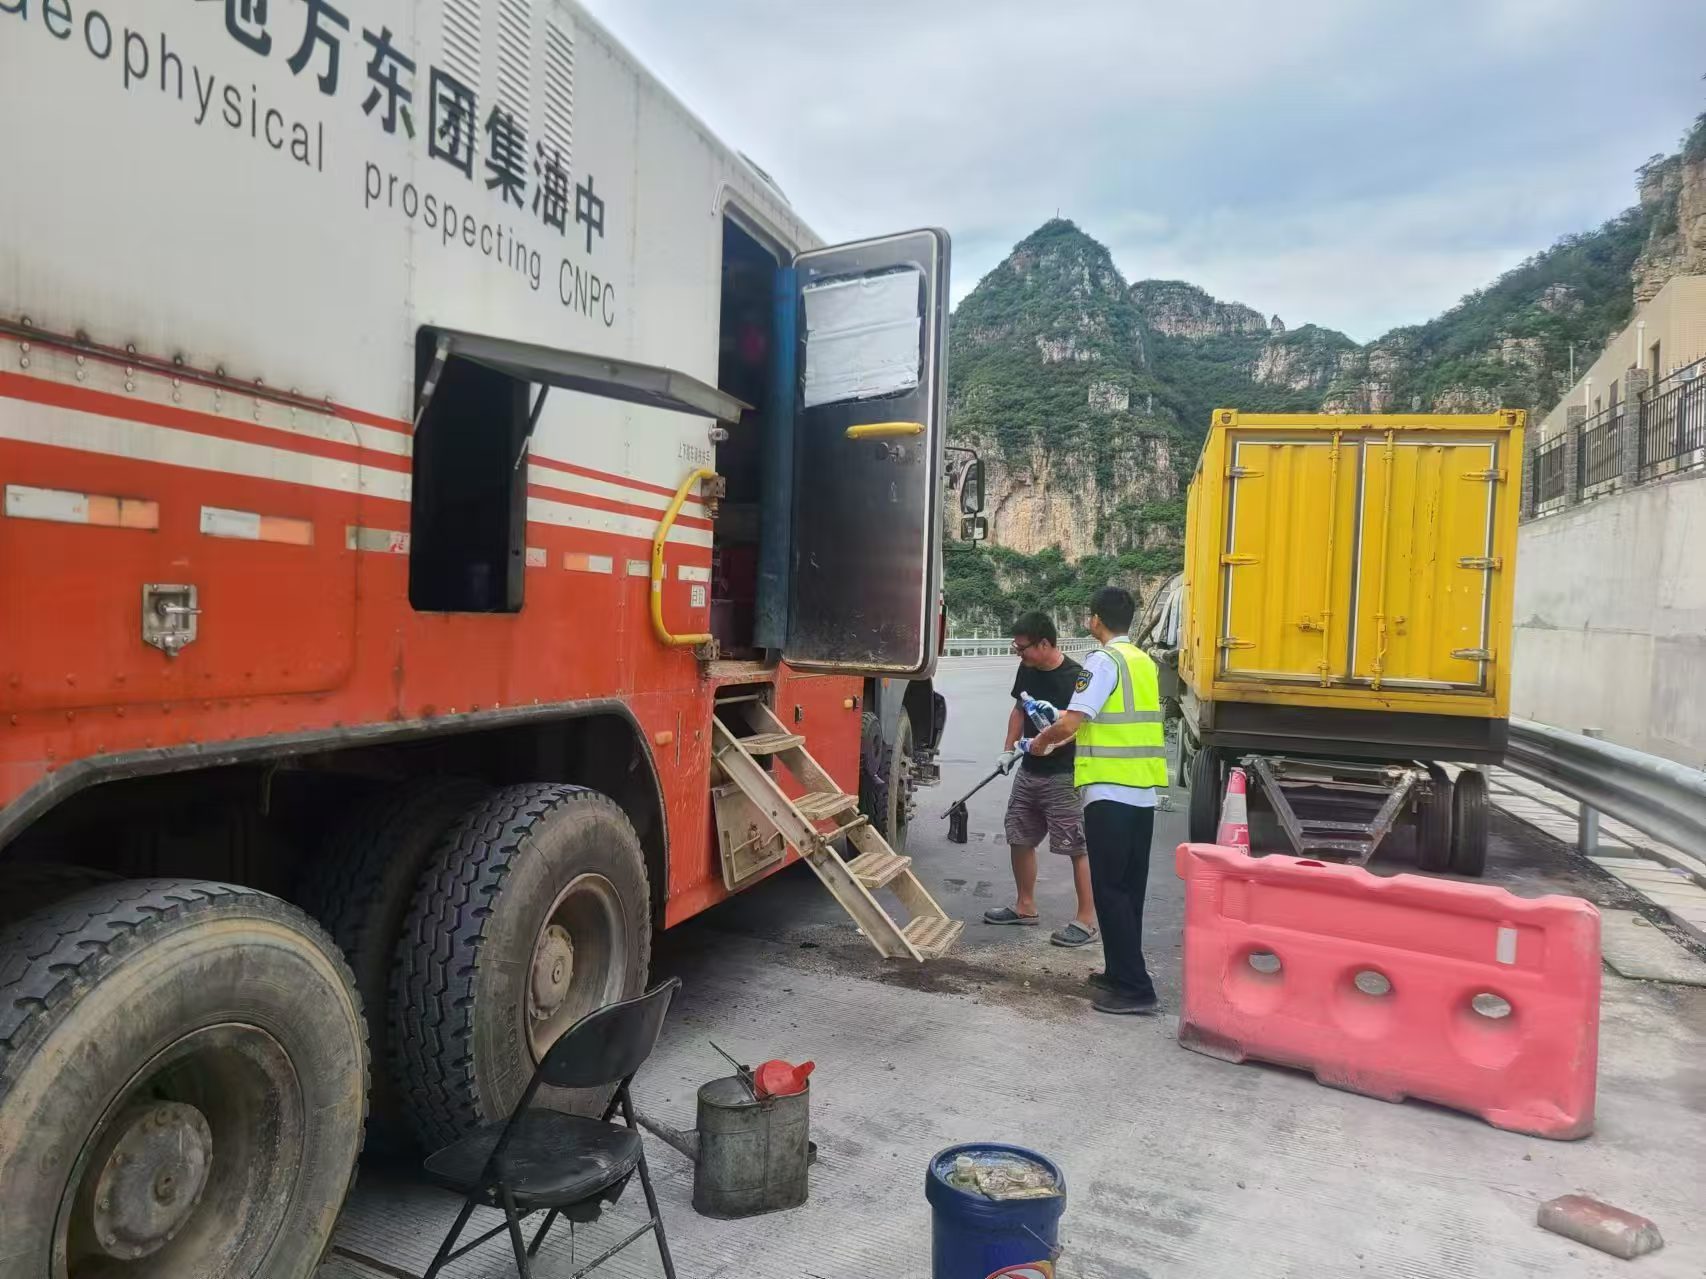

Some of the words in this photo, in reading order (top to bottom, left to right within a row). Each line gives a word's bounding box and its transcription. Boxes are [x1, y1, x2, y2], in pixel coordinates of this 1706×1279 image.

[0, 0, 323, 172] eophysical
[365, 159, 541, 291] prospecting
[558, 257, 615, 328] CNPC
